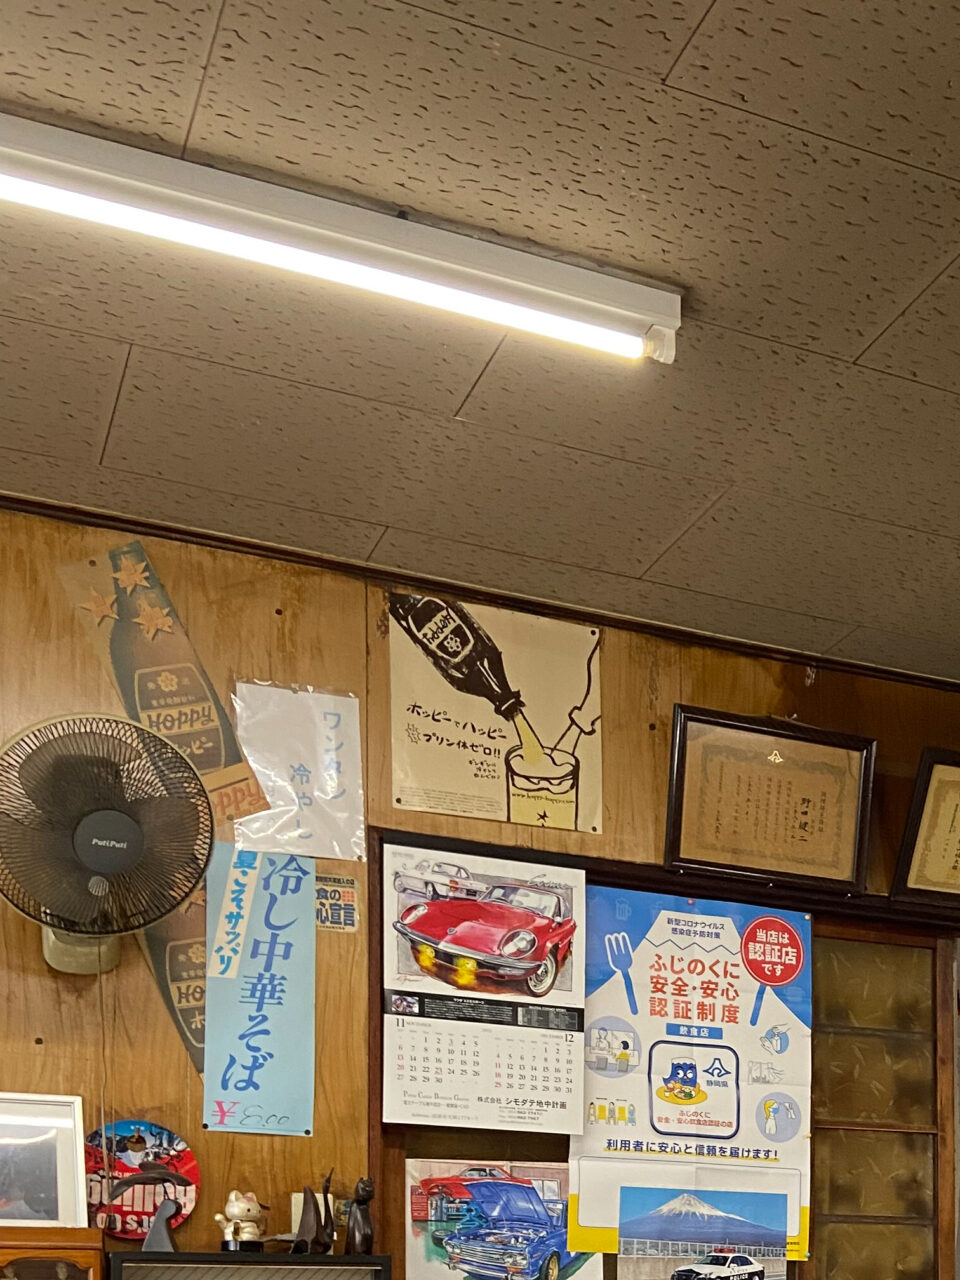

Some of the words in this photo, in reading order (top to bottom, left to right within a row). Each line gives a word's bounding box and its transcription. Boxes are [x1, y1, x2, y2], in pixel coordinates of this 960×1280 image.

[147, 704, 214, 732] Hoppy
[667, 917, 725, 930] 新型コロナウイルス
[671, 927, 721, 939] 感染症予防対策
[756, 929, 789, 944] 当店は
[748, 943, 797, 965] 認証店
[220, 854, 311, 1091] 冷し中華そば
[649, 954, 740, 980] ふじのくに
[762, 964, 784, 976] です
[649, 975, 740, 1001] 安全・安心
[649, 997, 740, 1024] 認証制度
[396, 1018, 405, 1027] 11
[565, 1034, 574, 1042] 12
[679, 1026, 709, 1037] 飲食店
[477, 1096, 502, 1104] 株式会社
[505, 1098, 567, 1109] シモダテ地中計画
[606, 1138, 778, 1160] 利用者に安心と信頼を届けます!
